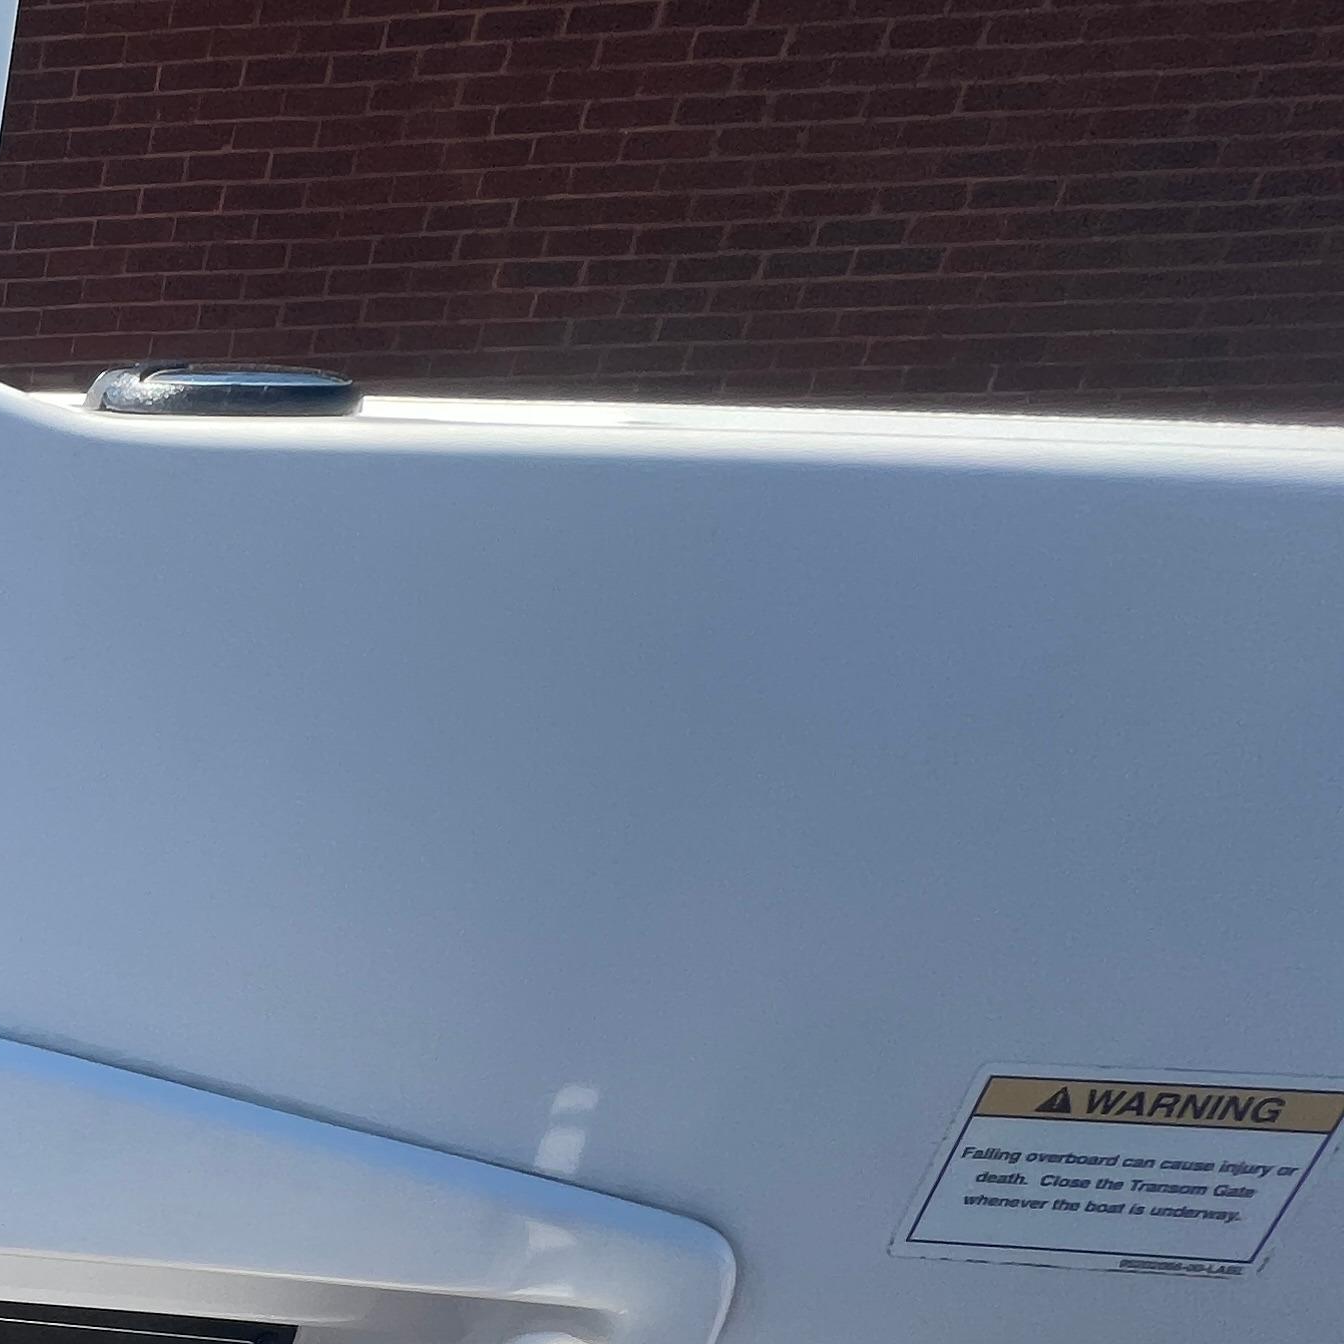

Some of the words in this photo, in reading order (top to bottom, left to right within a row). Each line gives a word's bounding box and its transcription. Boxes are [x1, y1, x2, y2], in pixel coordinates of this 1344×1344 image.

[1085, 1089, 1286, 1122] WARNING
[960, 1147, 1021, 1164] Falling
[1025, 1152, 1118, 1168] overboard
[1123, 1157, 1155, 1169] can
[1160, 1159, 1215, 1172] cause
[1219, 1160, 1273, 1177] injury
[1277, 1165, 1299, 1176] or
[976, 1172, 1028, 1185] death.
[1040, 1174, 1092, 1189] Close
[1096, 1178, 1125, 1190] the
[1129, 1179, 1208, 1196] Transom
[1213, 1184, 1257, 1199] Gate
[963, 1195, 1048, 1210] whenever
[1052, 1199, 1080, 1212] the
[1085, 1200, 1125, 1214] boat
[1128, 1202, 1145, 1216] is
[1149, 1206, 1241, 1223] underway.
